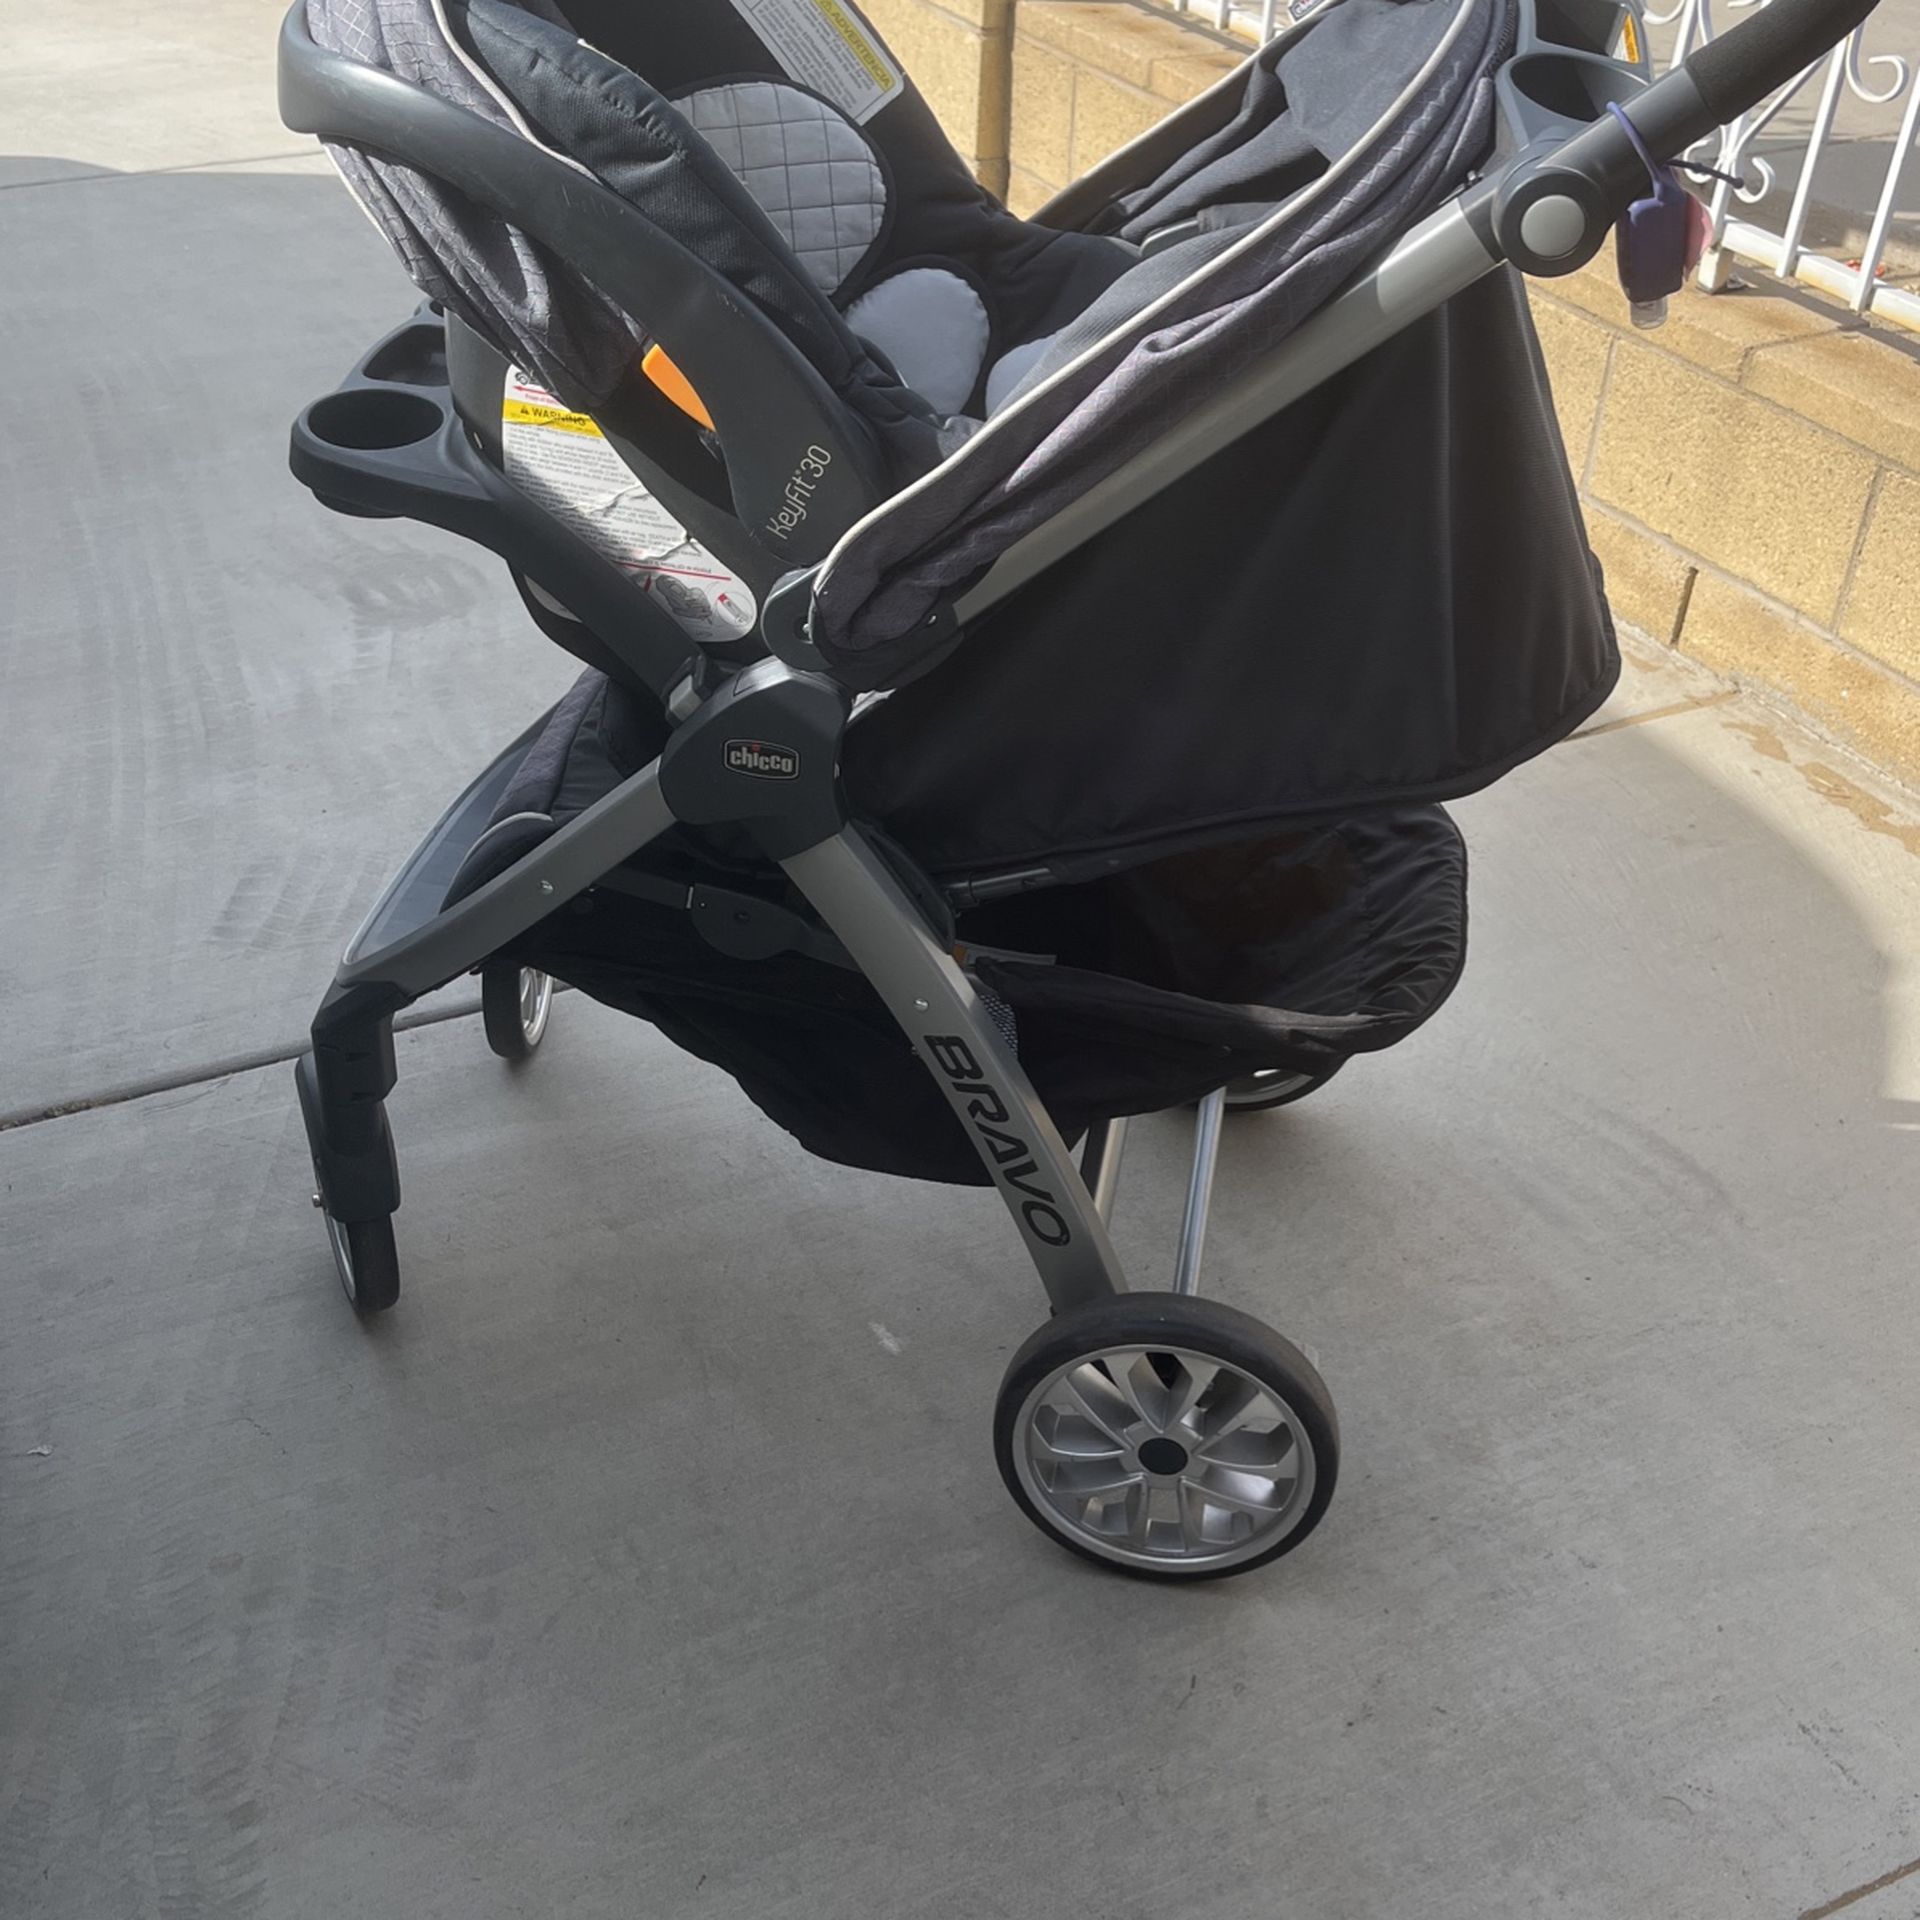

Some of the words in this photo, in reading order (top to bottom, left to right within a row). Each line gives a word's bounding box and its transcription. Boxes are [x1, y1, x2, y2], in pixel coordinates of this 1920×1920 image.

[831, 11, 891, 88] ADVERTENCIA
[532, 407, 587, 427] WARNING
[766, 475, 817, 540] KeyFit
[800, 445, 831, 478] 30
[730, 743, 793, 773] chicco
[923, 1034, 1071, 1247] BRAVO
